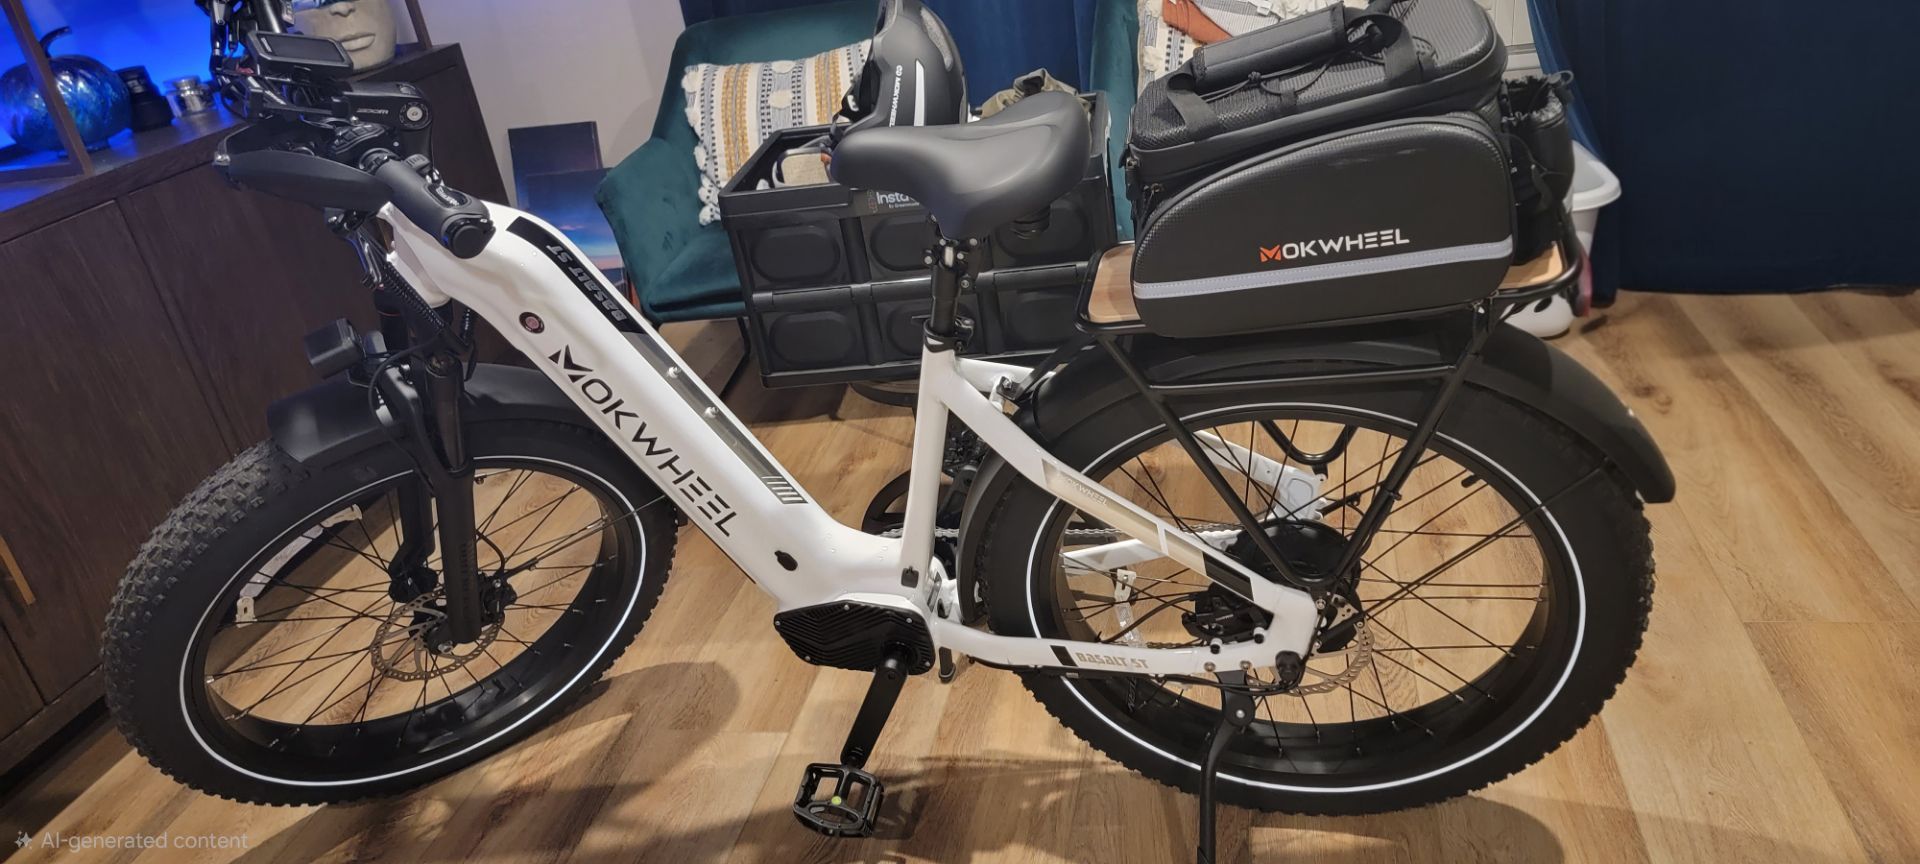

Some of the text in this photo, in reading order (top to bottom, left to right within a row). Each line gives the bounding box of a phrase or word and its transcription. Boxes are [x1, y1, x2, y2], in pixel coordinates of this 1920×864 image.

[546, 245, 573, 263] ST
[1259, 228, 1410, 263] MOKWHEEL
[548, 344, 737, 537] MOKWHEEL
[1130, 657, 1149, 669] ST
